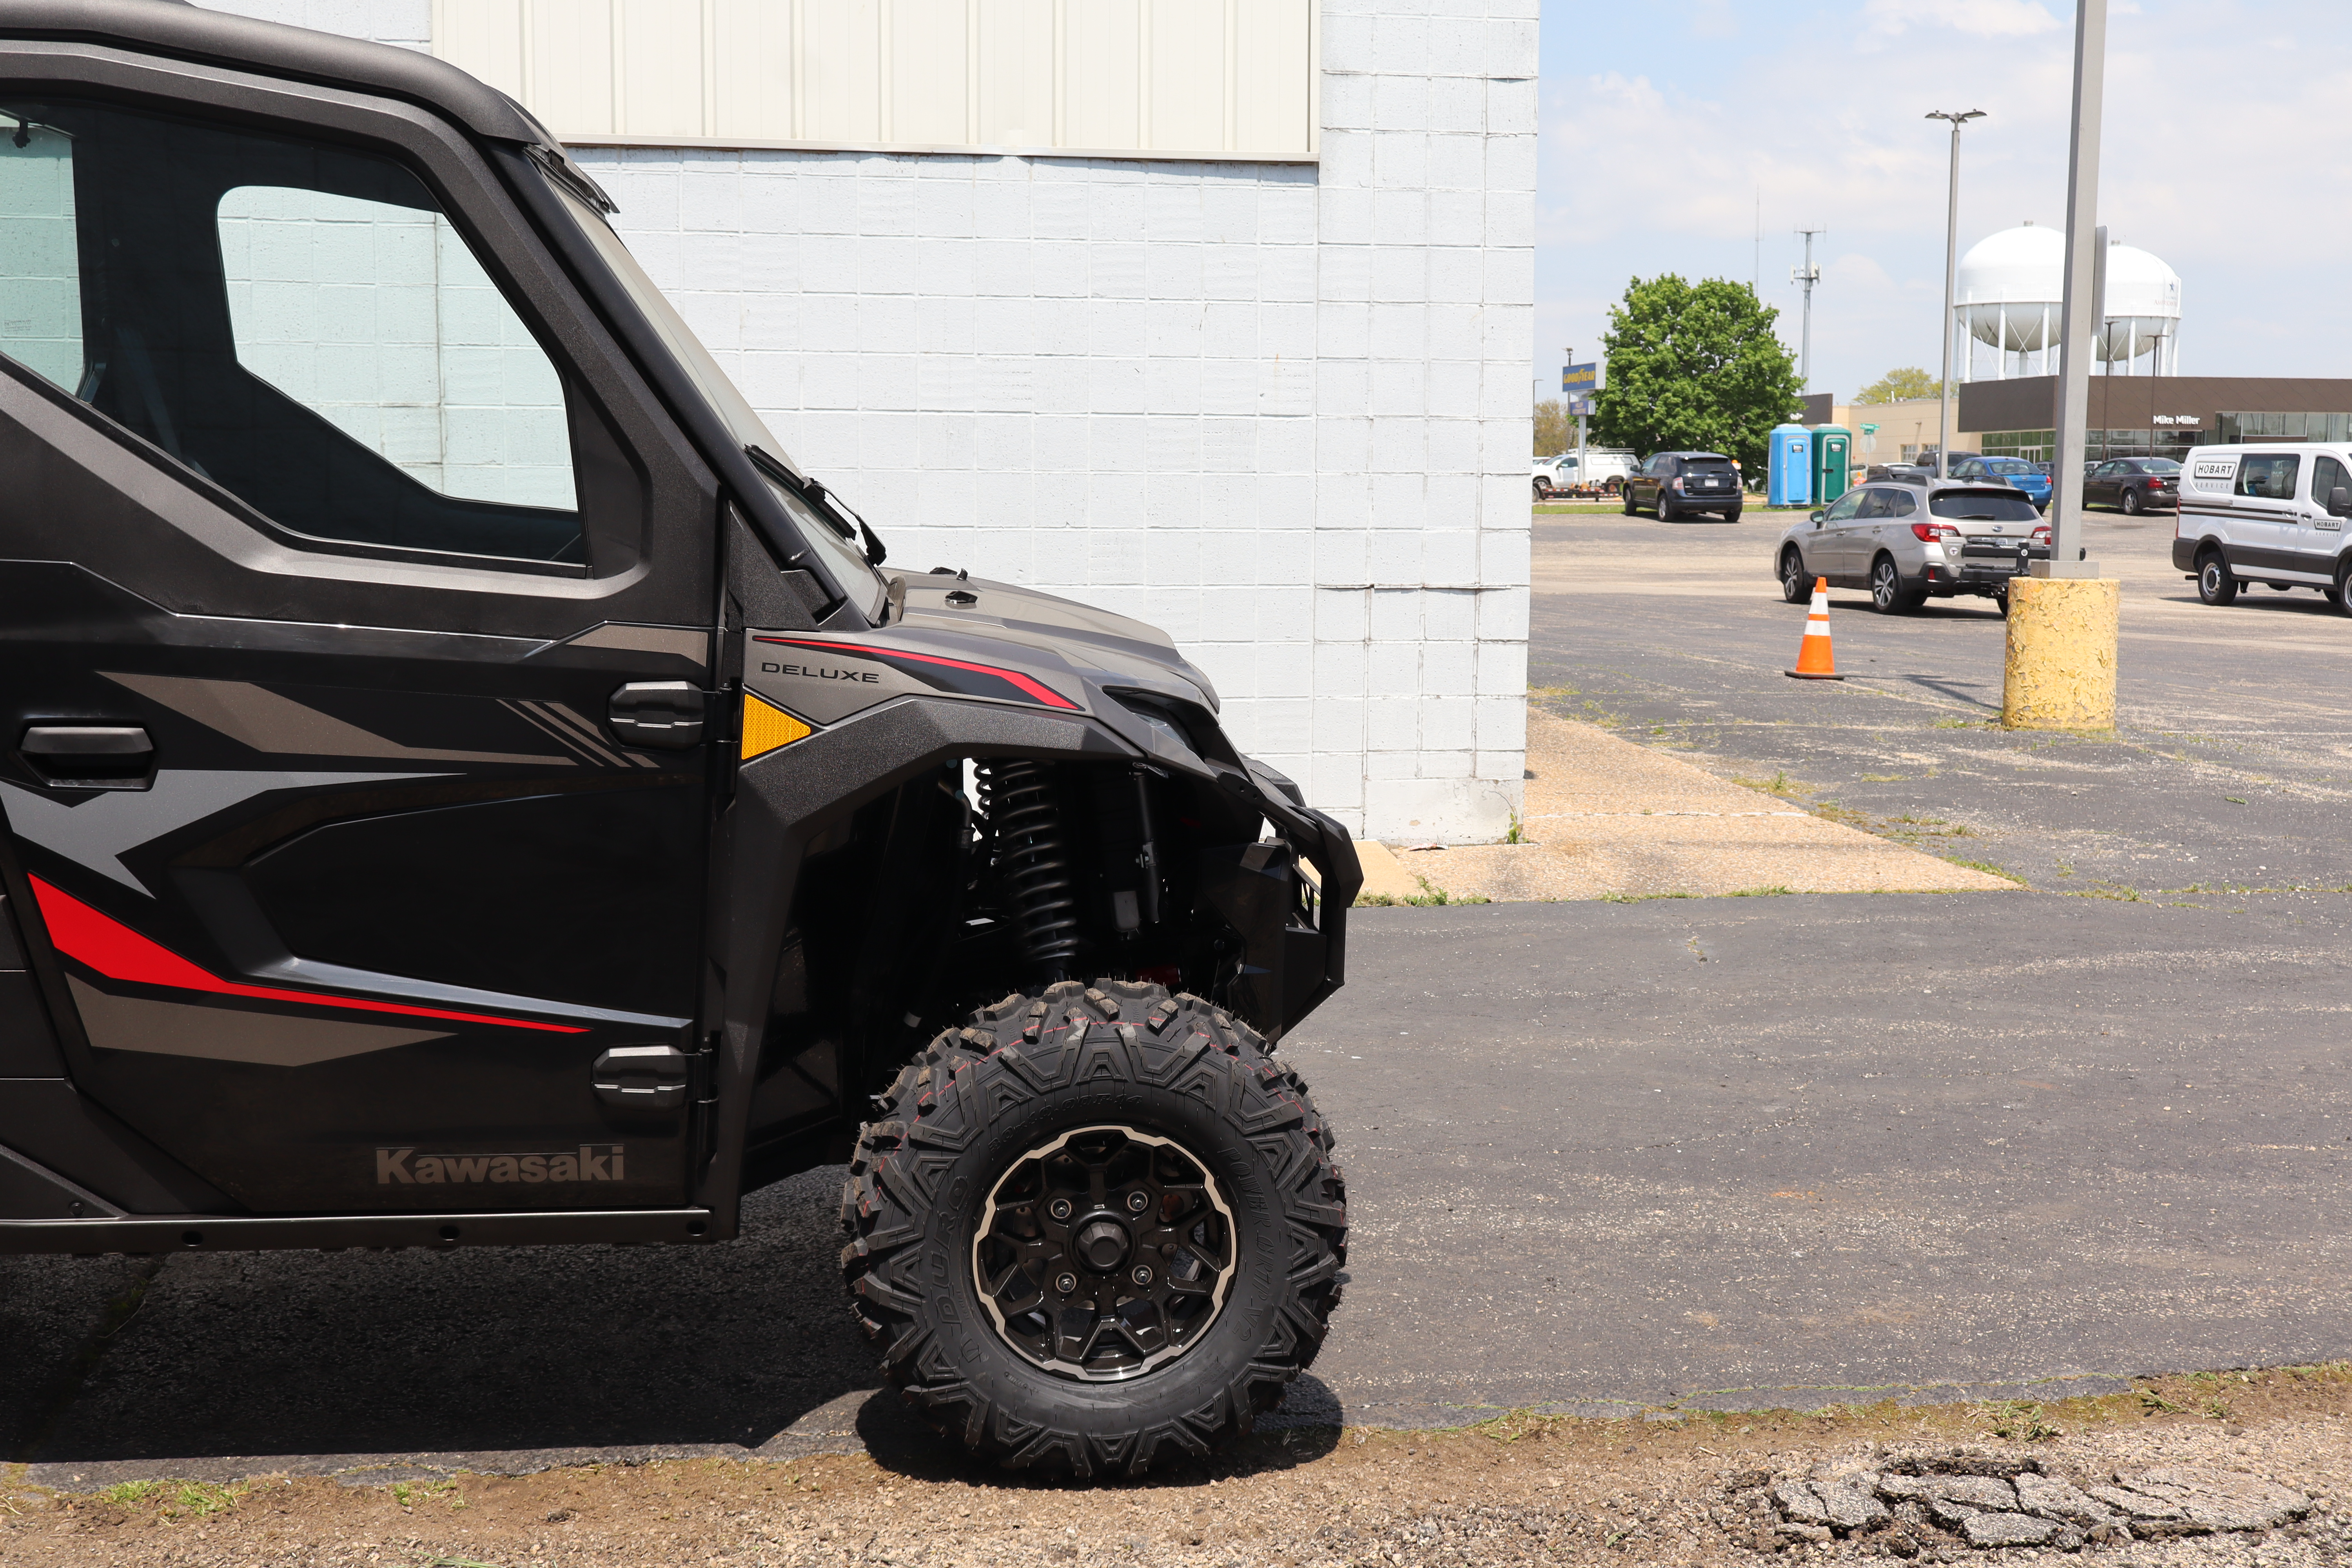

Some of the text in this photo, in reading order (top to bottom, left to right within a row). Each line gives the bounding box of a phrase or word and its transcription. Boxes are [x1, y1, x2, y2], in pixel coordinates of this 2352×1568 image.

[1564, 368, 1595, 385] GOODYEAR
[2153, 415, 2200, 424] Mike Miller
[2198, 465, 2232, 474] HOBART
[761, 662, 880, 684] DELUXE
[376, 1146, 624, 1184] Kawasaki
[931, 1176, 969, 1324] DURO
